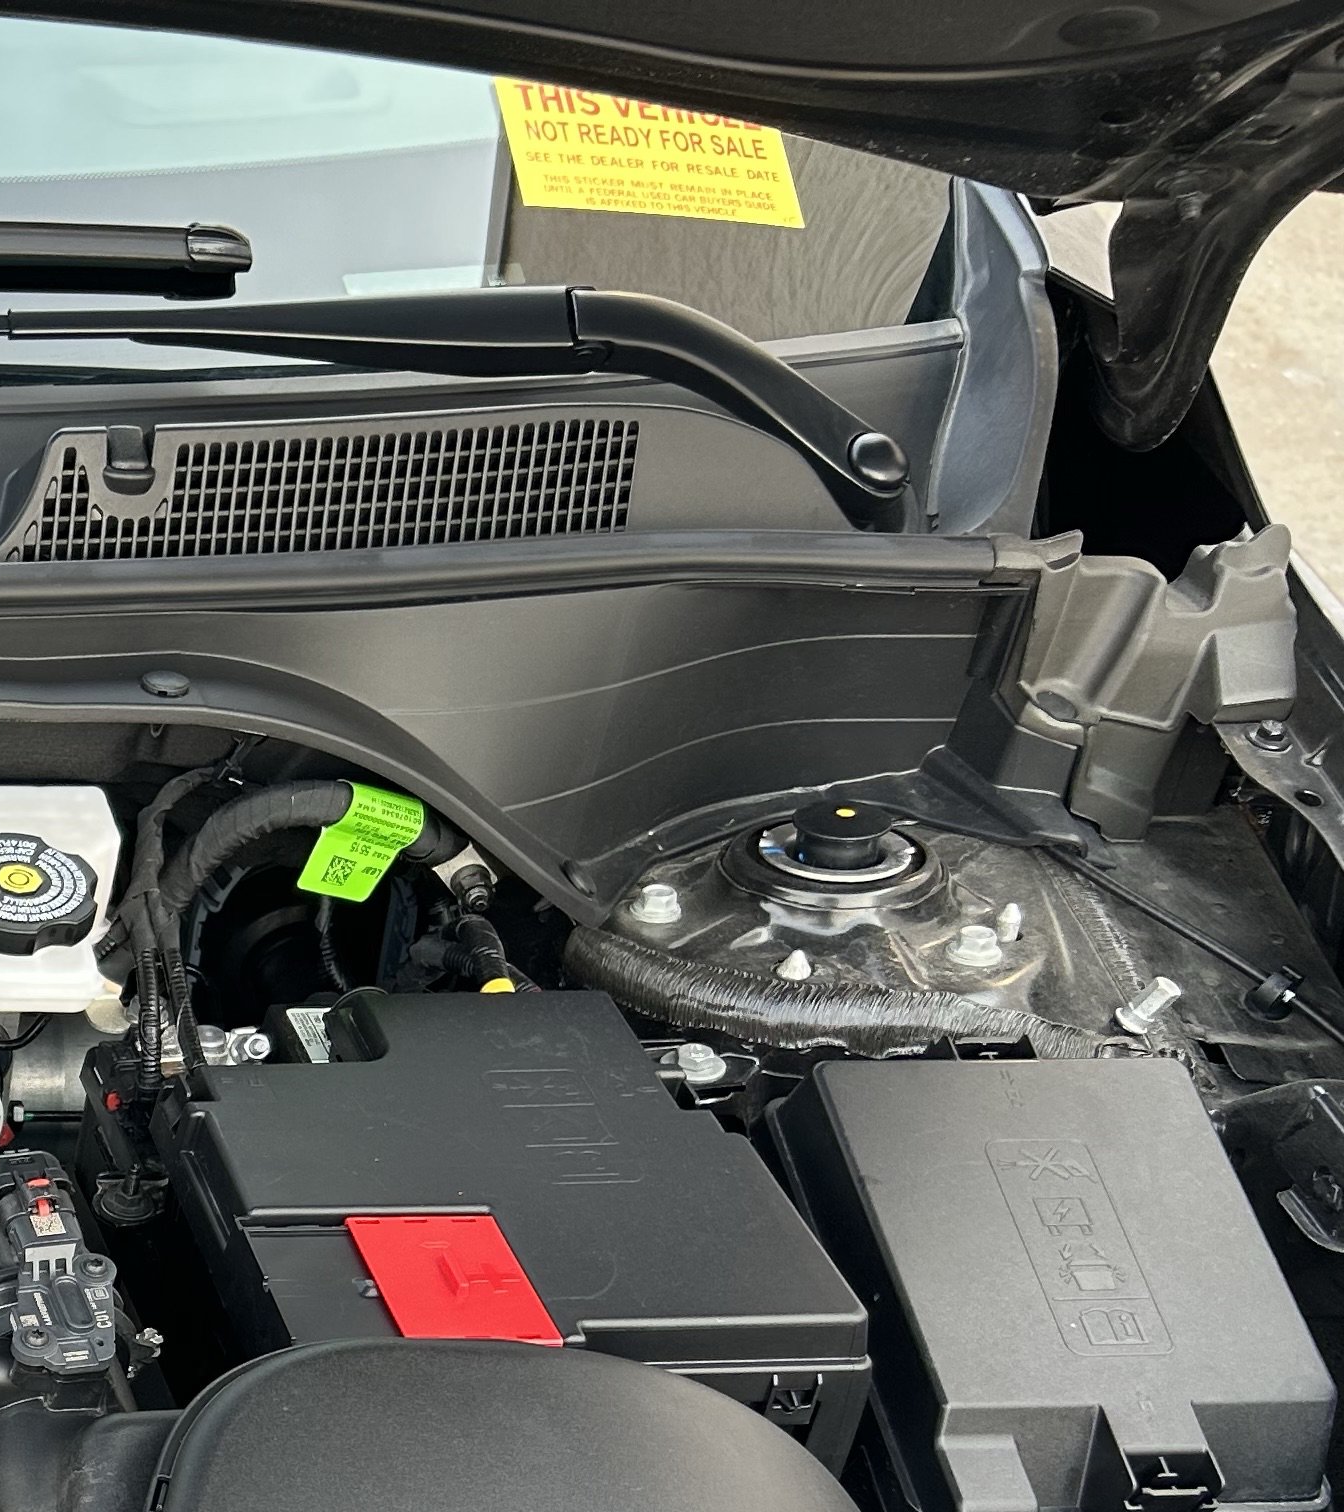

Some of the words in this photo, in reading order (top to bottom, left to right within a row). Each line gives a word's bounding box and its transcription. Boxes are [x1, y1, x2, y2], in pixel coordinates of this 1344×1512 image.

[514, 83, 601, 116] THIS
[524, 119, 569, 142] NOT
[577, 123, 651, 148] READY
[659, 130, 706, 154] FOR
[710, 134, 768, 160] SALE
[525, 151, 551, 163] SEE
[558, 153, 584, 165] THE
[591, 155, 644, 169] DEALER
[652, 159, 679, 172] FOR
[686, 163, 740, 178] RESALE
[746, 169, 780, 183] DATE
[543, 174, 570, 184] THIS
[574, 175, 625, 187] STICKER
[630, 179, 664, 191] MUST
[670, 183, 717, 194] REMAIN
[721, 186, 732, 196] IN
[736, 189, 773, 201] PLACE
[543, 185, 573, 194] UNTIL
[578, 186, 585, 195] A
[589, 187, 637, 199] FEDERAL
[641, 191, 671, 201] USED
[674, 193, 696, 203] CAR
[699, 196, 741, 207] BUYERS
[745, 200, 777, 211] GUIDE
[600, 198, 646, 209] AFFIXED
[651, 202, 663, 210] TO
[668, 203, 691, 213] THIS
[695, 206, 738, 217] VEHICLE
